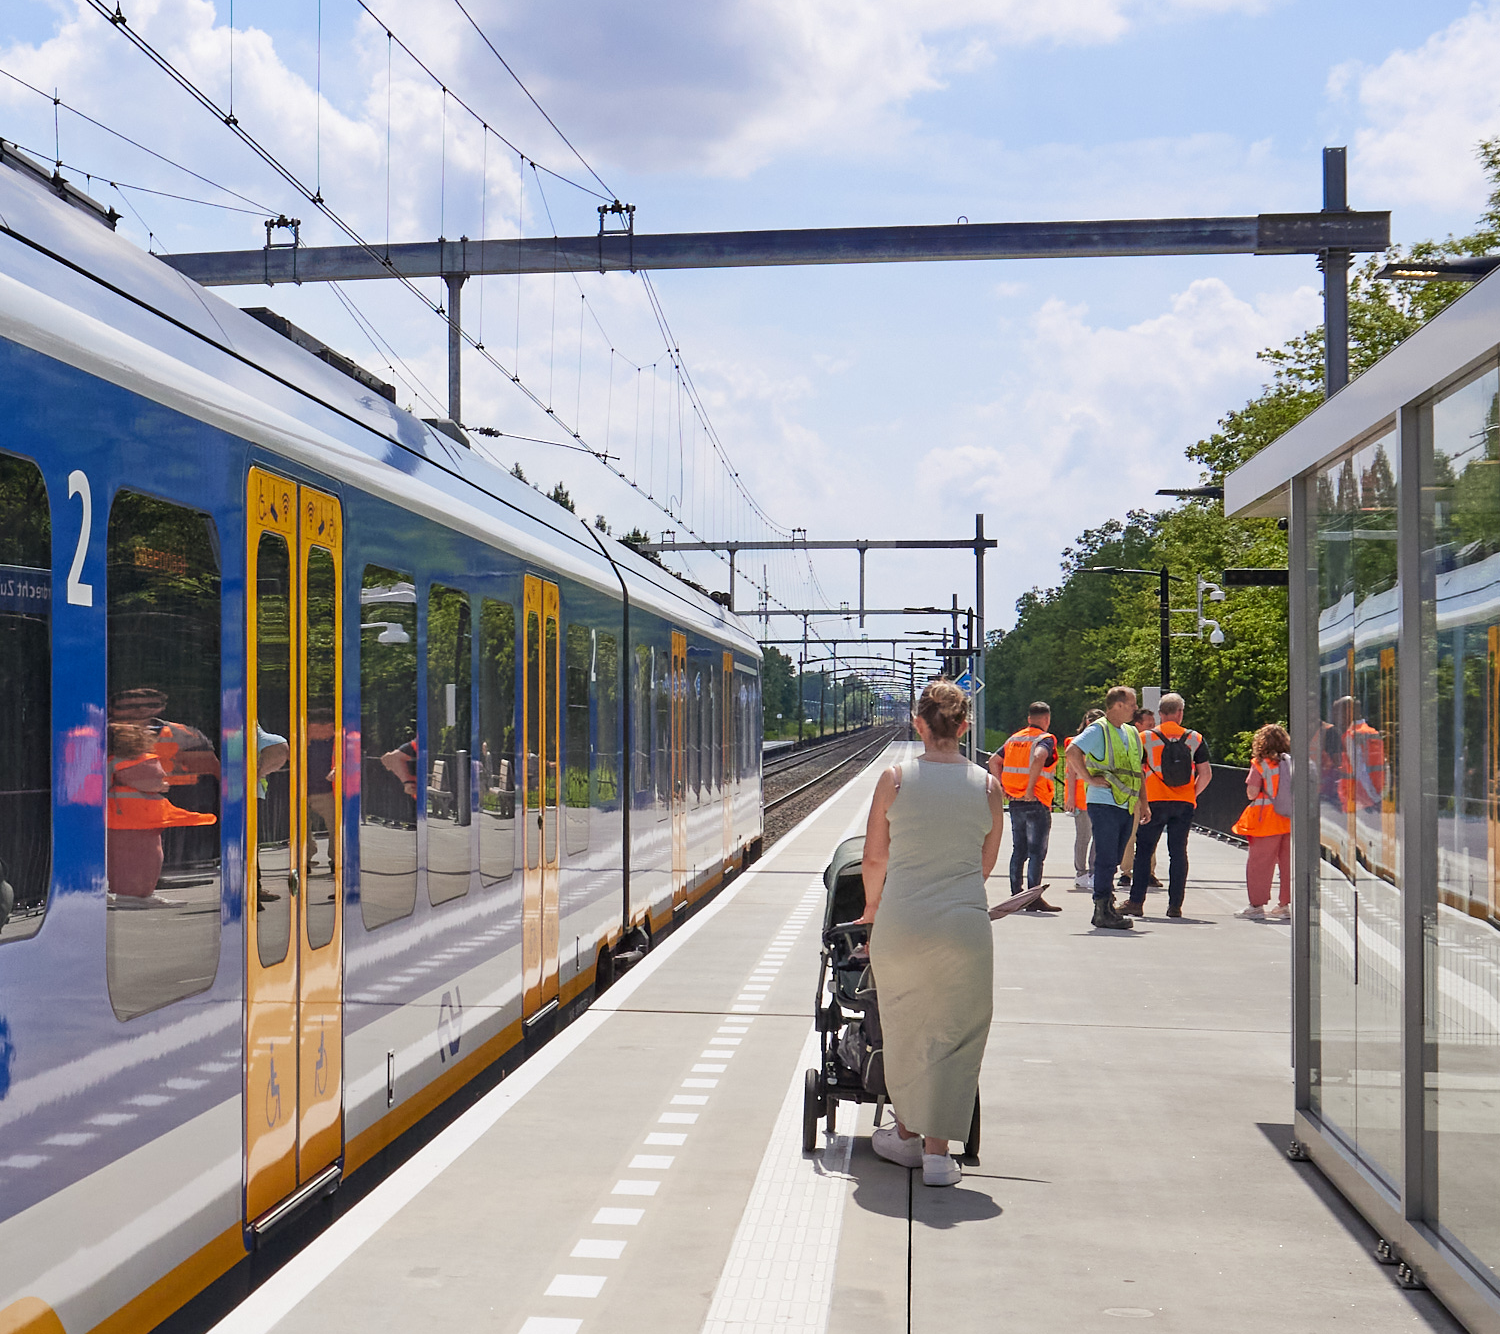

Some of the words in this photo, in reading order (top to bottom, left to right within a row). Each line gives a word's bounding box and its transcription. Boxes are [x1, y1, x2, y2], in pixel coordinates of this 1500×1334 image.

[67, 469, 93, 607] 2
[590, 628, 597, 682] 2
[963, 680, 971, 692] 3
